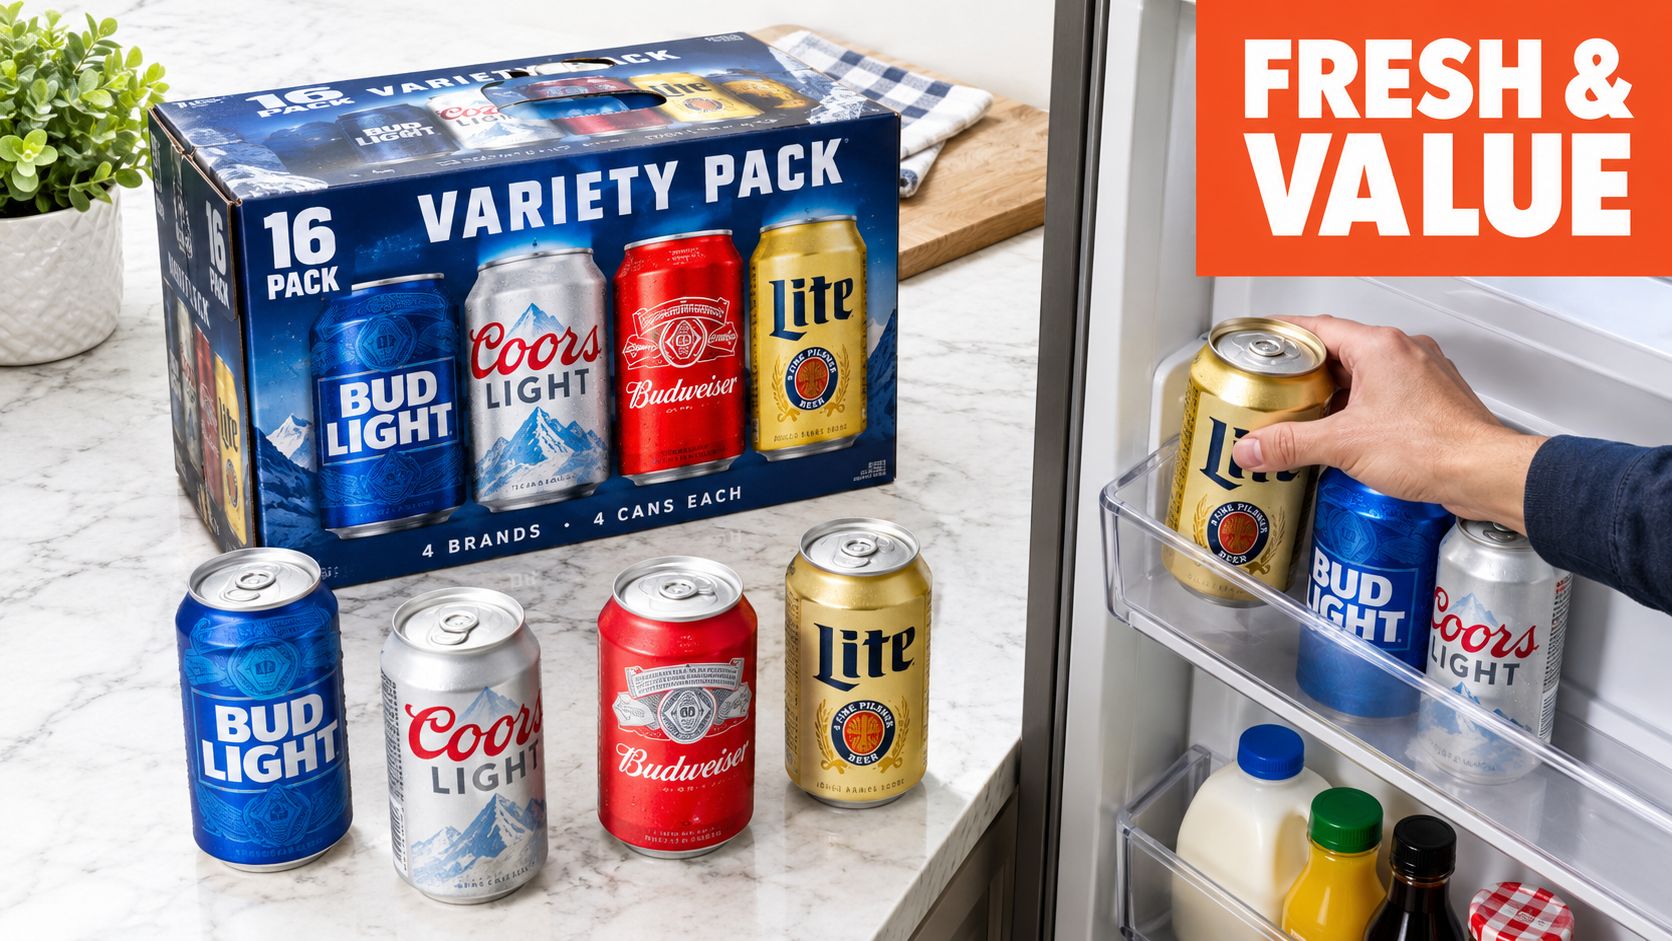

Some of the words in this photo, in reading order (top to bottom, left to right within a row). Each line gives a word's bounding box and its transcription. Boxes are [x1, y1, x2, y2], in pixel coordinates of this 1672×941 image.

[245, 86, 344, 109] 16
[257, 97, 355, 118] PACK
[362, 121, 422, 136] BUD
[417, 160, 679, 244] VARIETY
[704, 138, 843, 204] PACK
[206, 200, 226, 275] 16
[263, 206, 336, 269] 16
[266, 266, 340, 300] PACK
[769, 276, 854, 341] Lite
[469, 321, 602, 380] Coors
[339, 370, 438, 418] BUD
[486, 368, 589, 409] LIGHT
[625, 374, 737, 409] Budweiser
[327, 402, 452, 457] LIGHT
[422, 544, 434, 559] 4
[448, 524, 541, 554] BRANDS
[593, 512, 605, 526] 4
[617, 499, 674, 522] CANS
[687, 486, 742, 509] EACH
[1312, 546, 1393, 607] BUD
[812, 622, 915, 692] Lite
[1431, 635, 1520, 686] LIGHT
[215, 693, 324, 743] BUD
[404, 687, 543, 762] Coors
[201, 719, 338, 783] LIGHT
[431, 738, 539, 795] LIGHT
[616, 740, 749, 782] Budweiser
